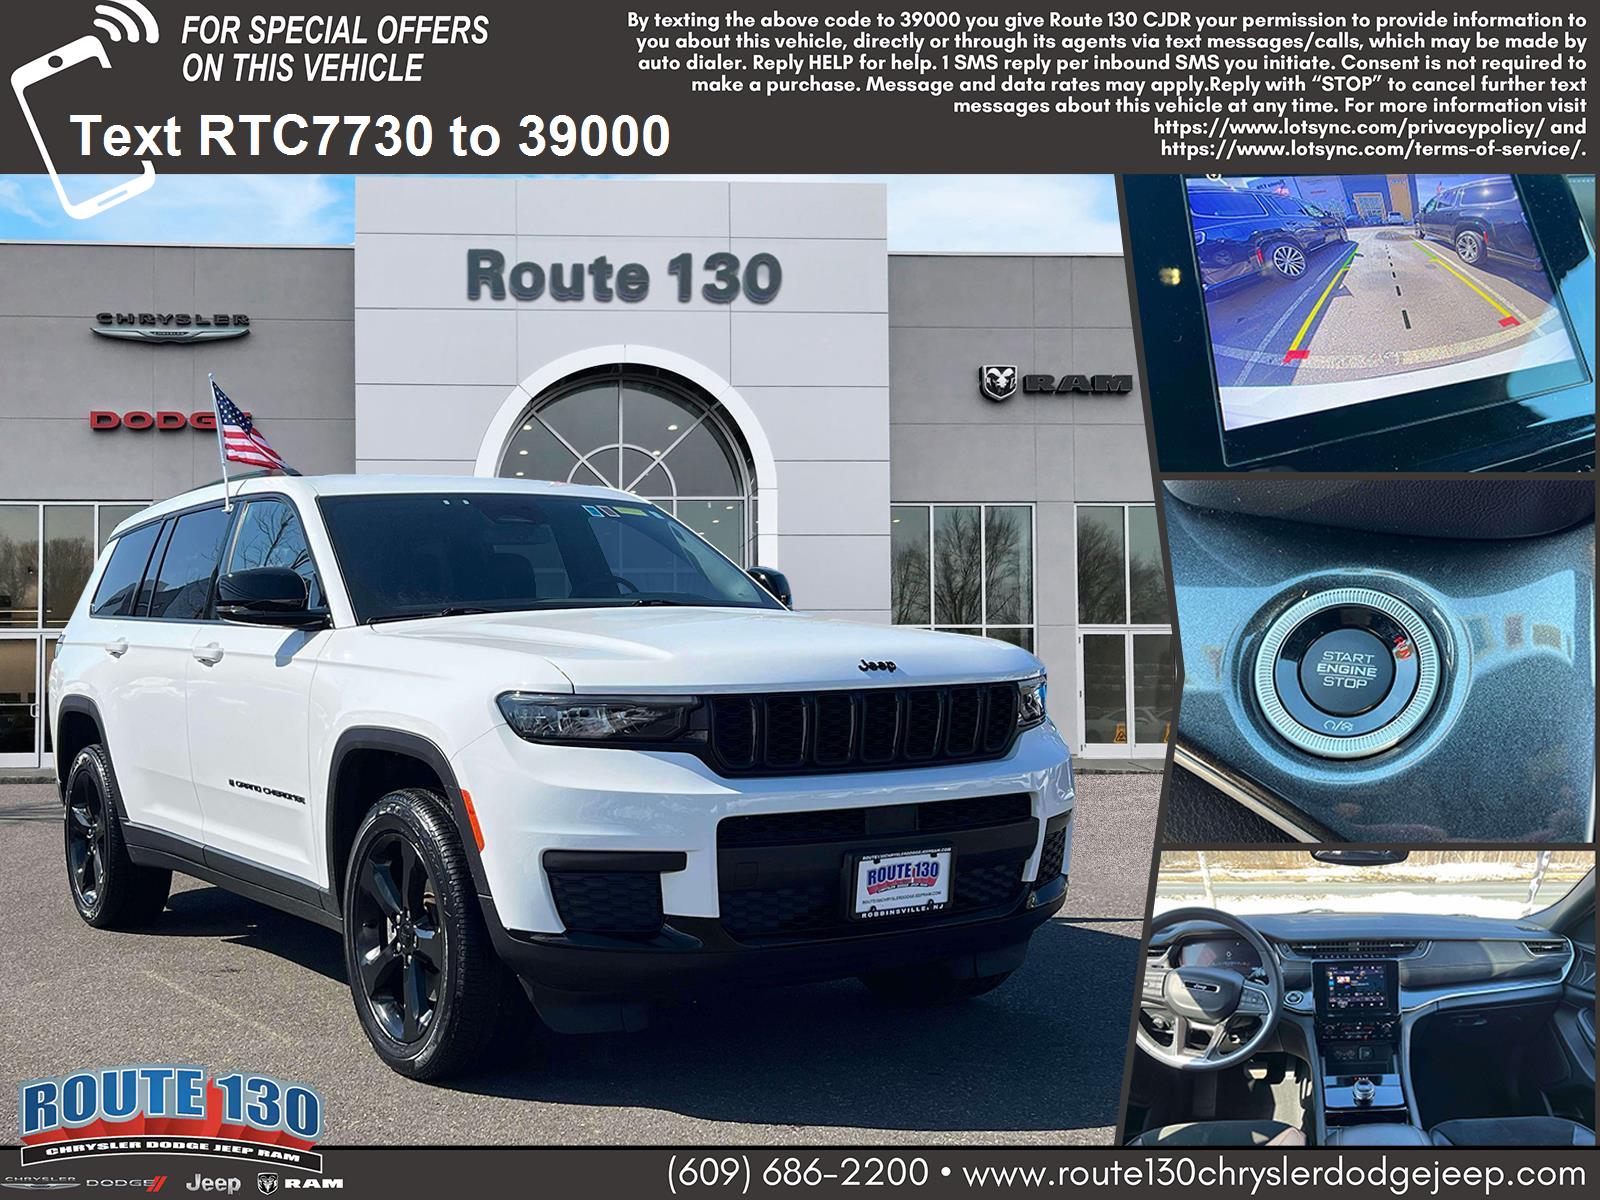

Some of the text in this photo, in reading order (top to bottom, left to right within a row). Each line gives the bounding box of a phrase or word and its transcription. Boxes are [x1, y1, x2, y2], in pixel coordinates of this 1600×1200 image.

[467, 248, 782, 304] Route 130
[96, 312, 250, 326] CHRYSLER
[1023, 374, 1133, 395] RAM
[90, 411, 251, 430] DODG
[1322, 651, 1375, 664] START
[858, 659, 897, 673] Jeep
[1316, 662, 1378, 678] ENGINE
[1322, 676, 1368, 689] STOP
[867, 862, 939, 885] ROUTE 130
